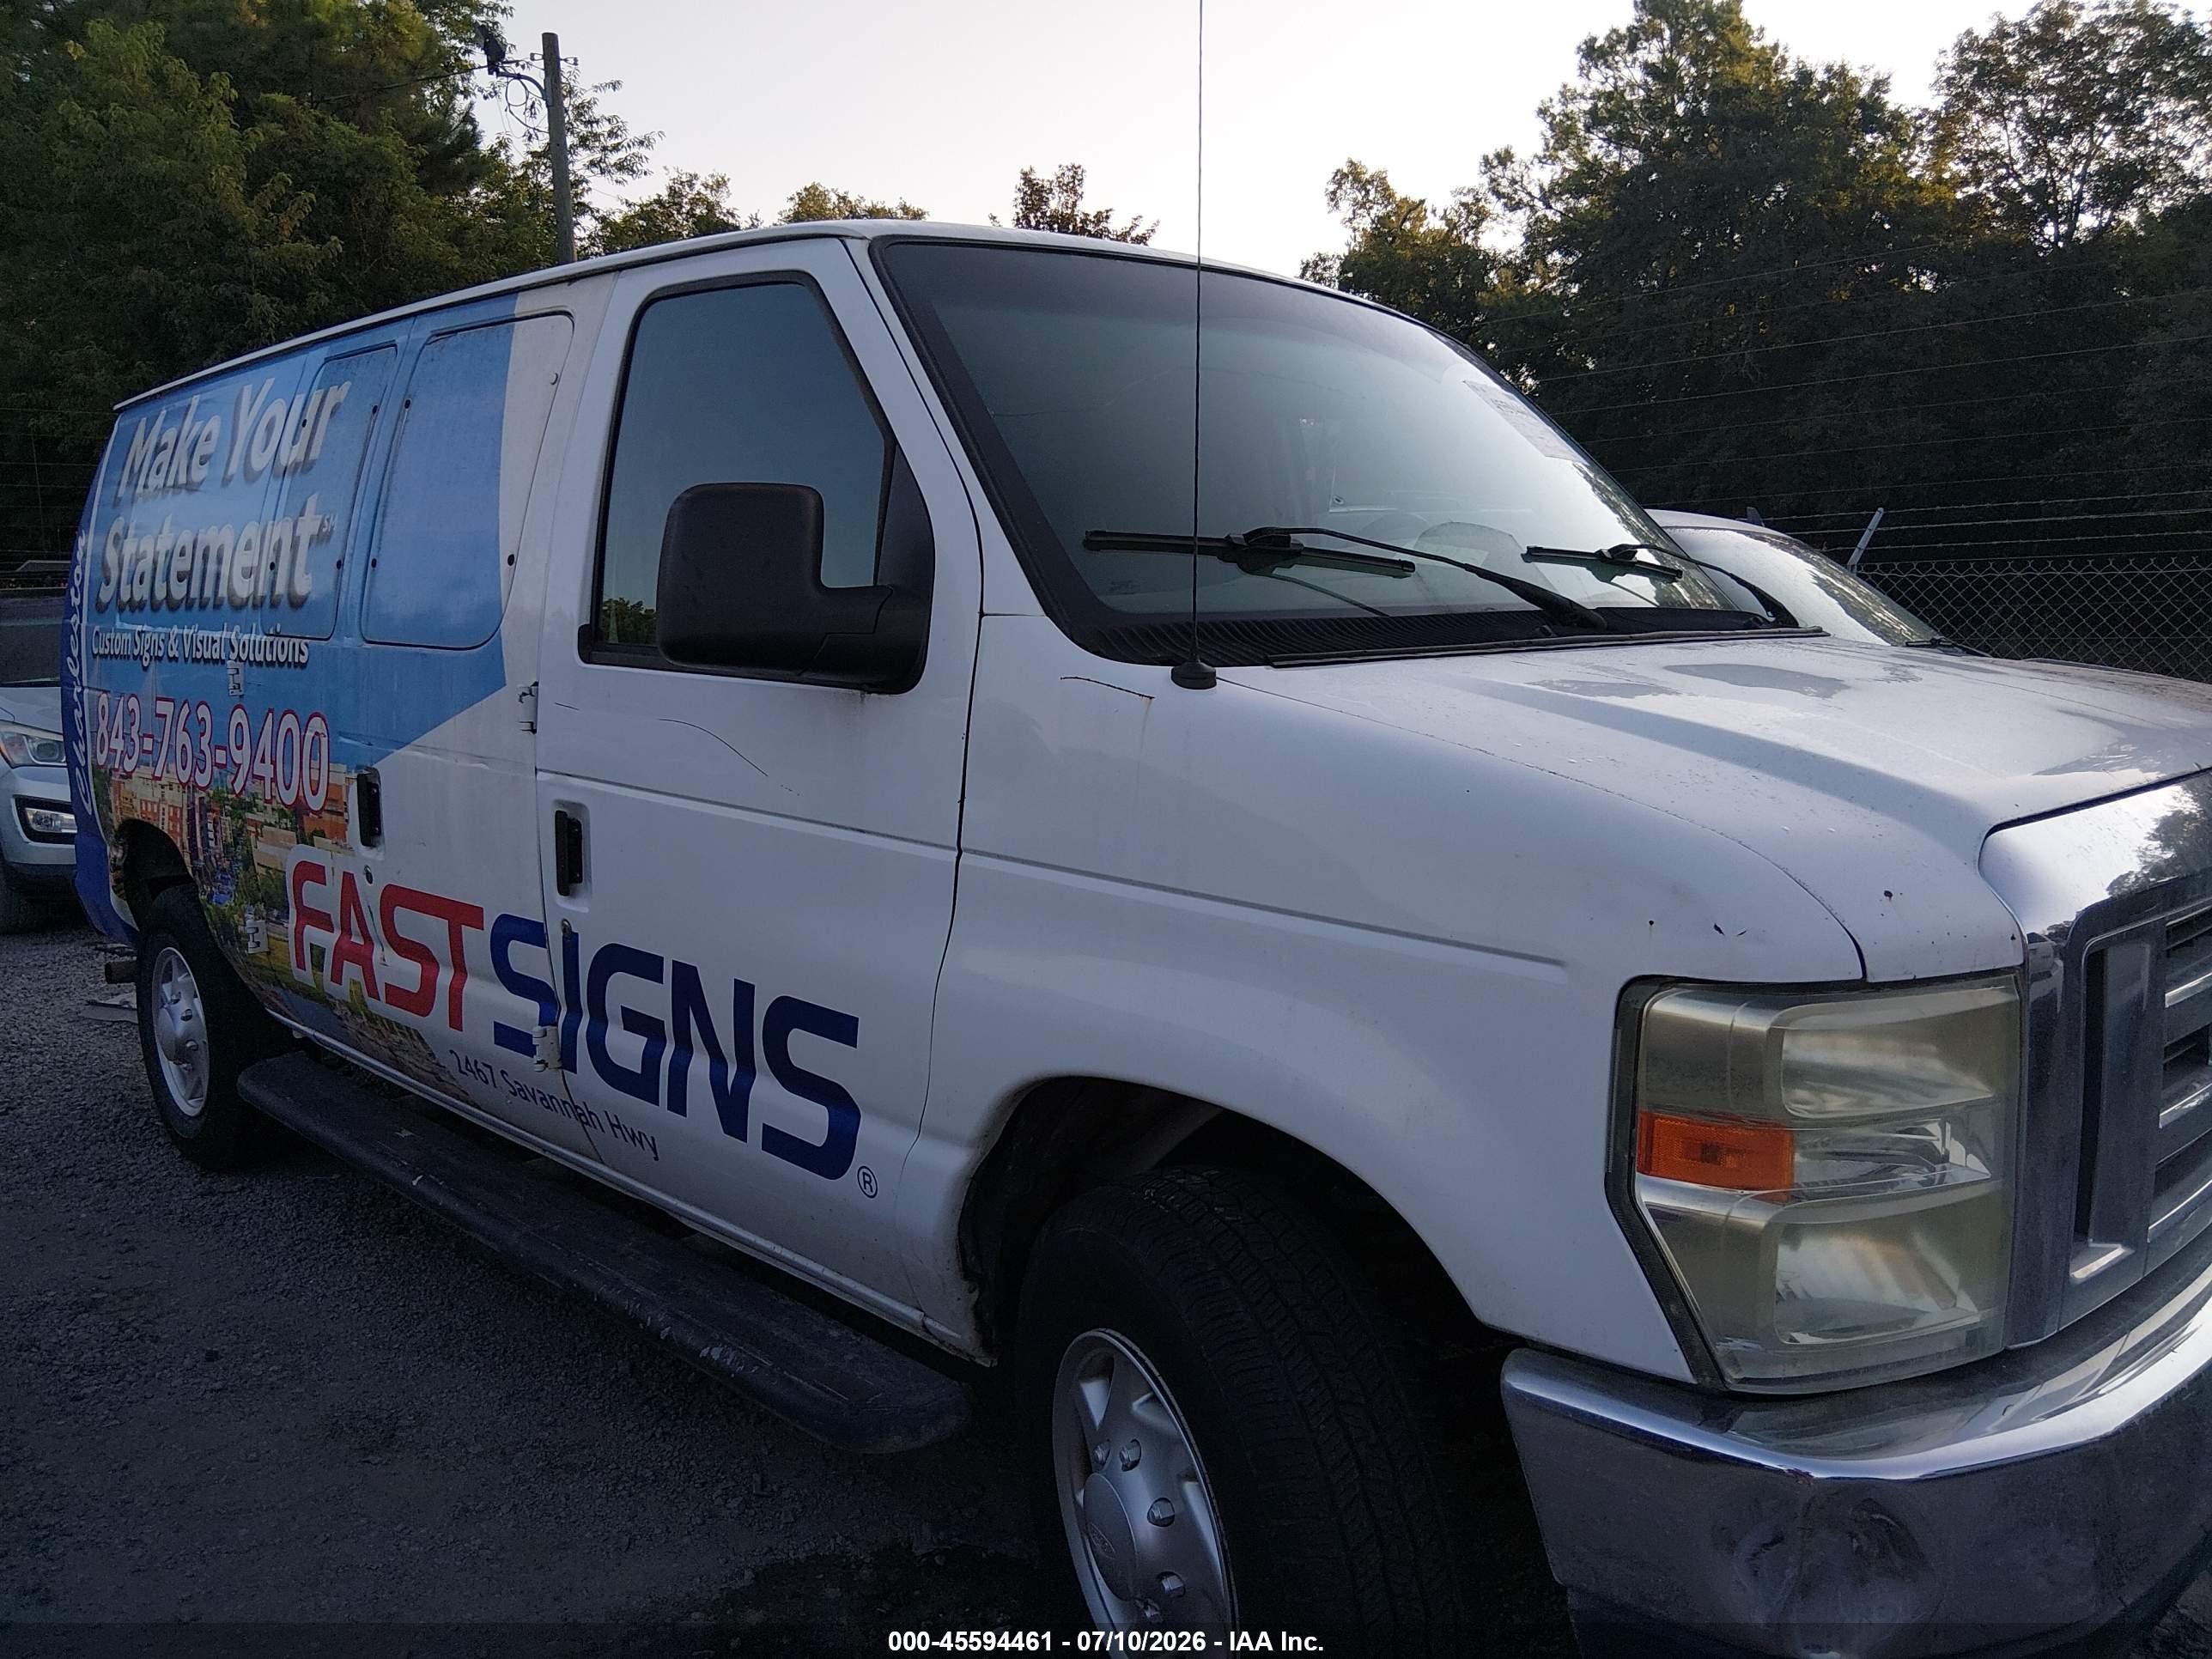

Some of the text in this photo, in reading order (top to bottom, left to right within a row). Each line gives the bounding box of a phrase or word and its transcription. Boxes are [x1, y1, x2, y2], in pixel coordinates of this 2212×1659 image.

[117, 378, 352, 498] Make Your
[99, 494, 319, 602] Statement
[66, 530, 93, 816] Charleston
[92, 623, 309, 667] Custom Signs & Visual Solutions
[96, 691, 330, 814] 843-763-9400
[449, 1049, 659, 1161] 2467 Savannah Hwy
